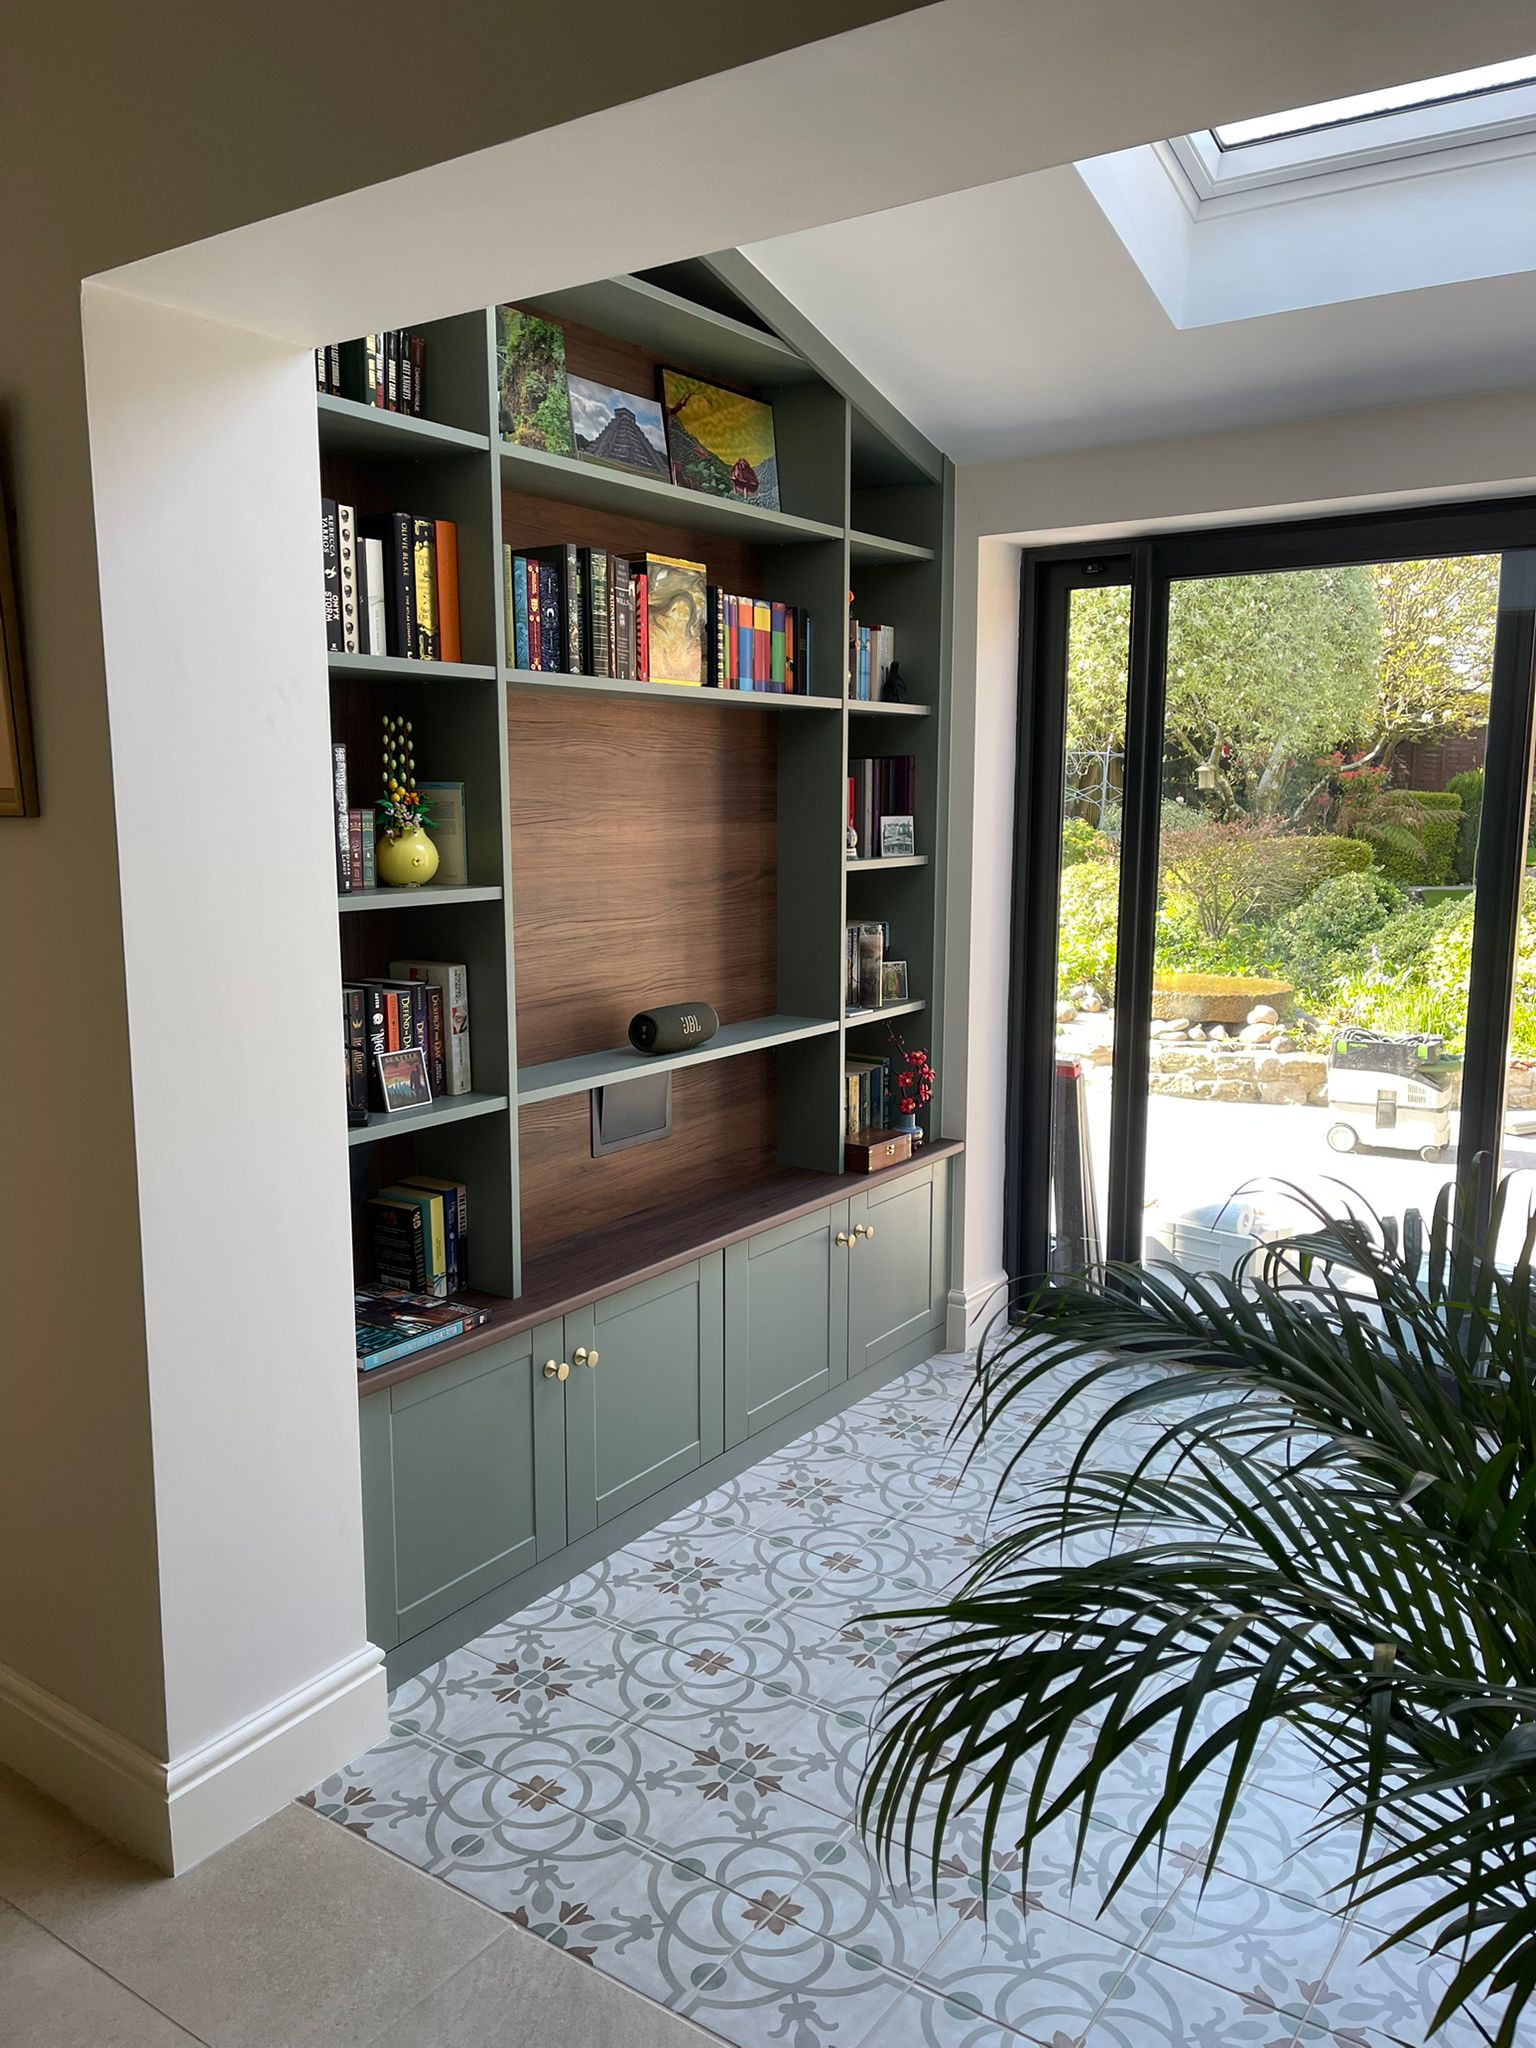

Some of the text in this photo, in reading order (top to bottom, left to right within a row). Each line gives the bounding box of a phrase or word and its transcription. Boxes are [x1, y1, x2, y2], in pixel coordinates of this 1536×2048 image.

[388, 359, 396, 383] DOUBLE
[402, 359, 411, 376] GREY
[388, 382, 397, 402] EAGLE
[402, 375, 412, 401] KNIGHTS
[322, 517, 330, 554] YARROS
[328, 515, 336, 557] REBECCA
[400, 523, 408, 549] OLIVIE
[325, 591, 333, 622] STORM
[332, 595, 340, 621] ONYX
[401, 996, 411, 1030] DEFEND
[431, 994, 440, 1030] DESTROY
[681, 1014, 702, 1035] JBL
[416, 1021, 424, 1047] DEFY
[384, 1053, 419, 1064] SEATTLE
[434, 1040, 443, 1058] DAY
